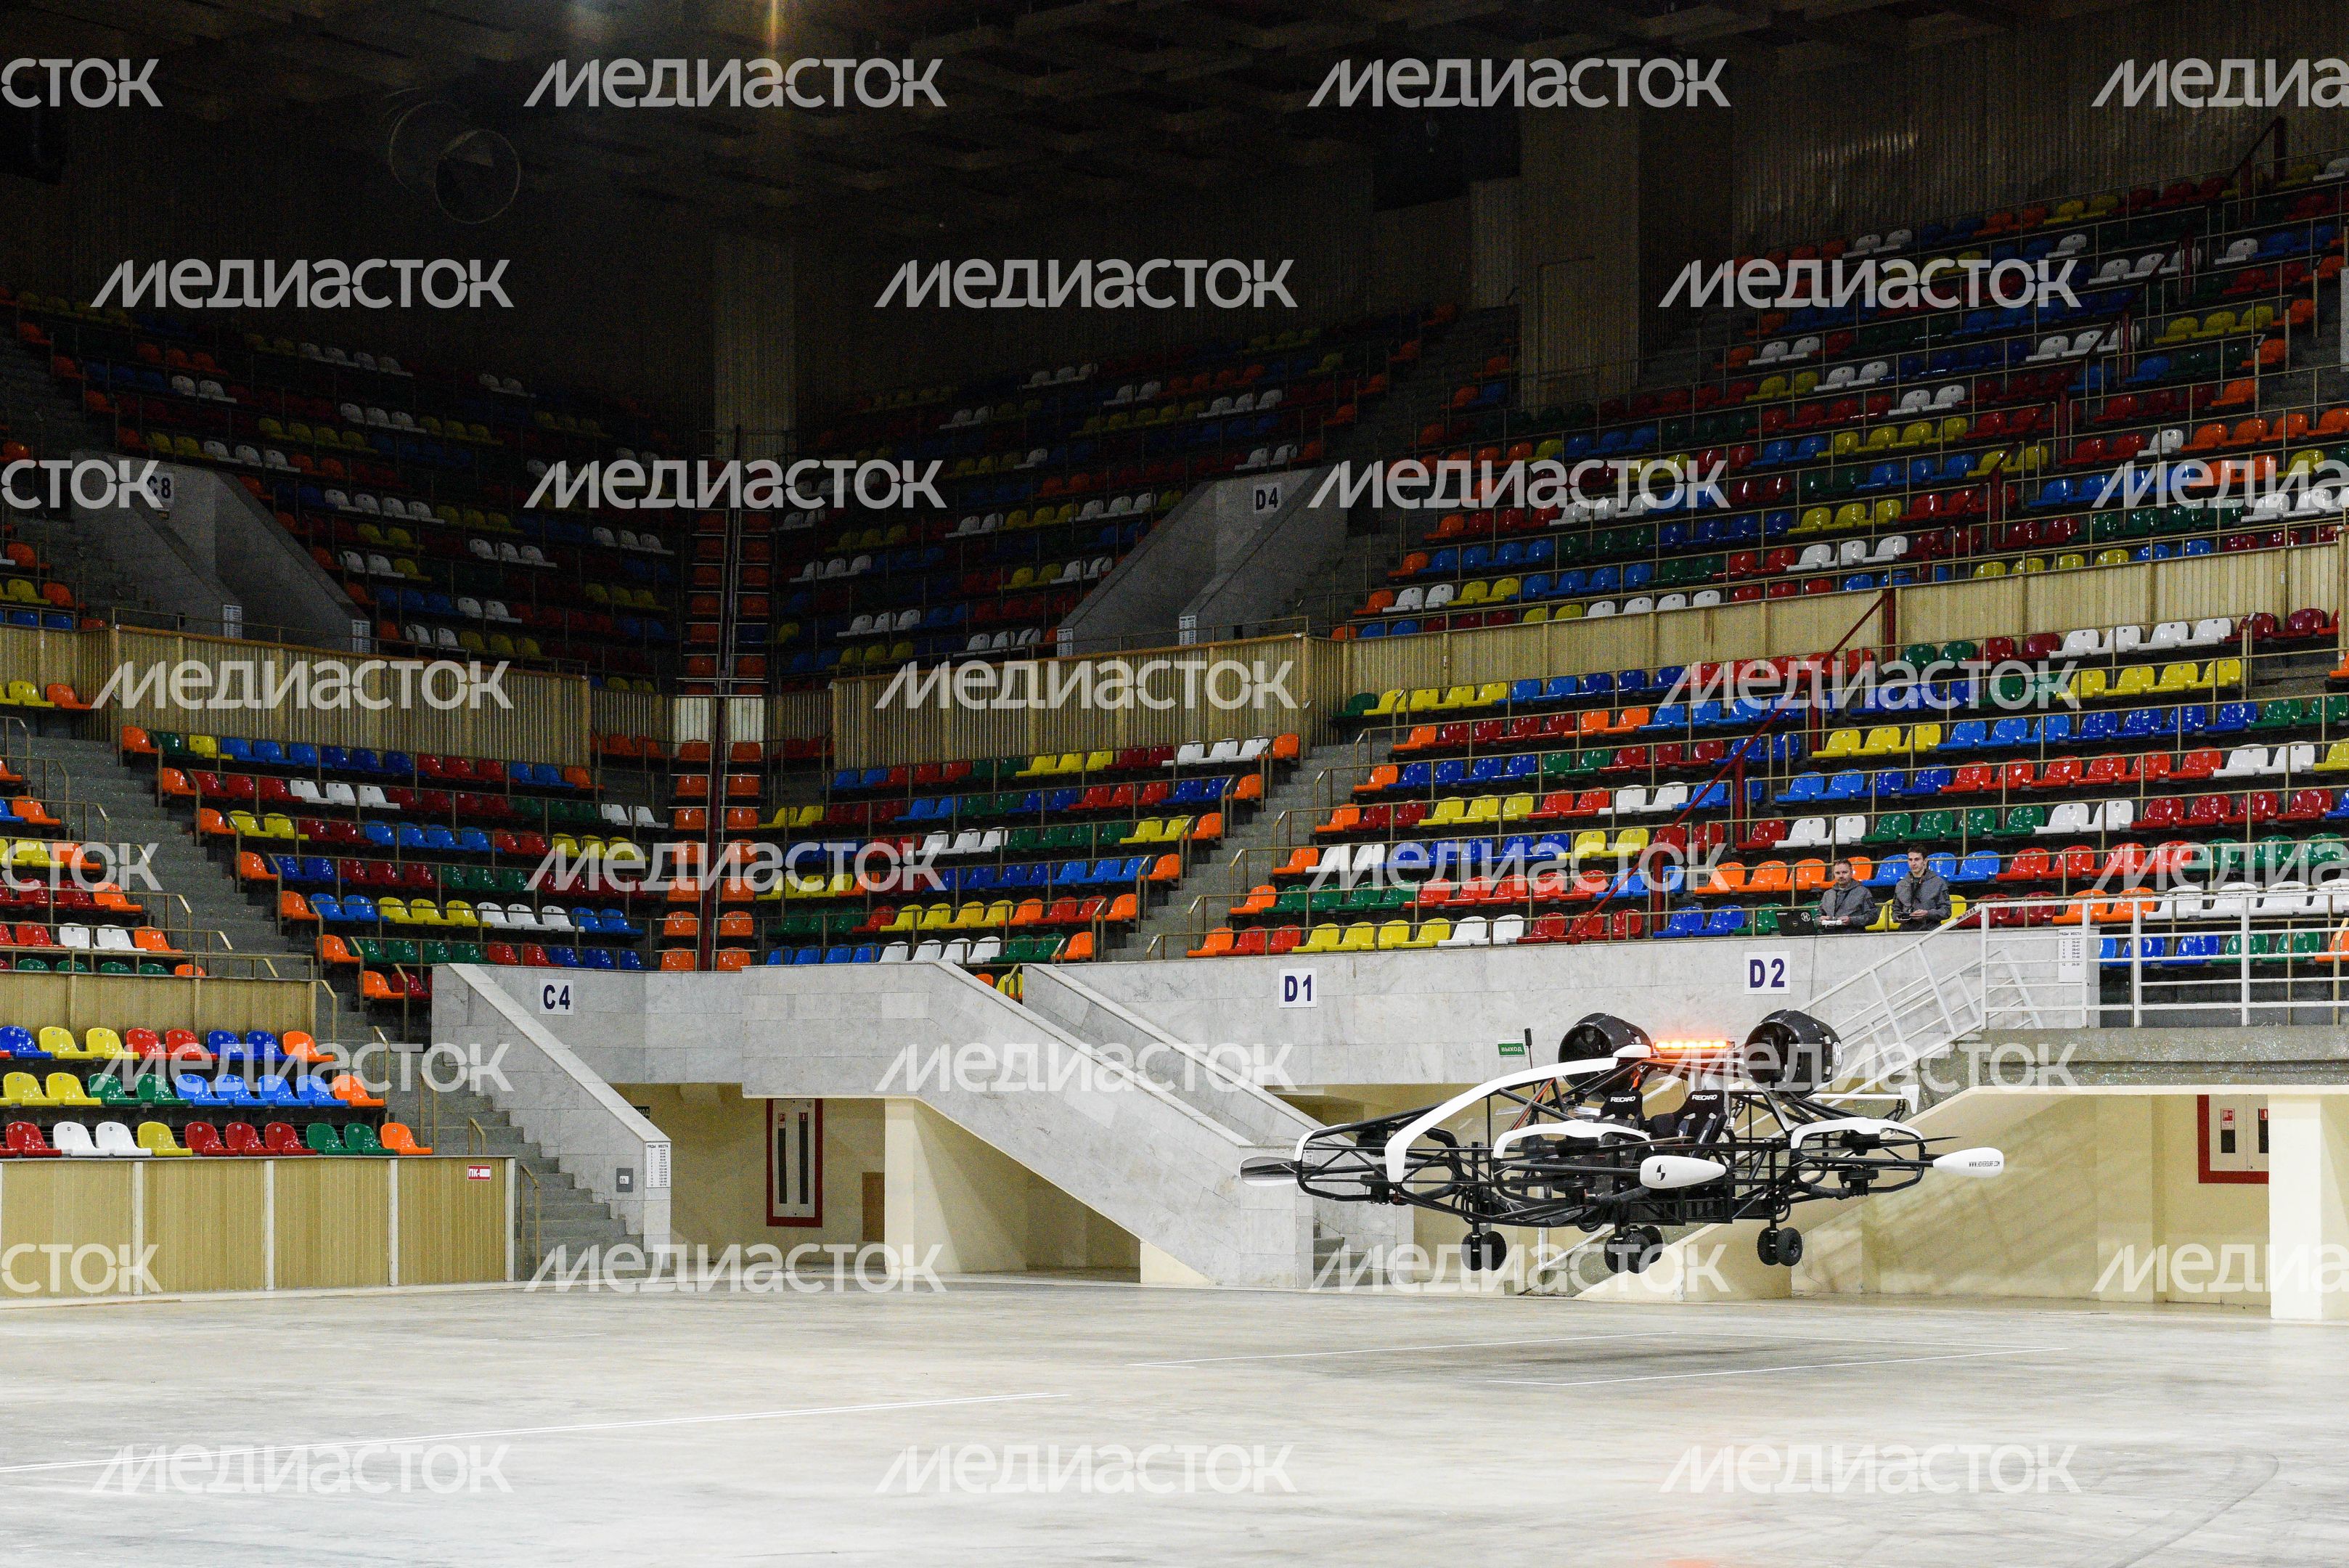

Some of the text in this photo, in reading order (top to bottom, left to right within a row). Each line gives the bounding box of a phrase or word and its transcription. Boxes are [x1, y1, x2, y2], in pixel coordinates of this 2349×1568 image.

[1256, 487, 1278, 510] D4
[1749, 958, 1785, 988] D2
[543, 984, 571, 1010] C4
[1284, 975, 1312, 1002] D1
